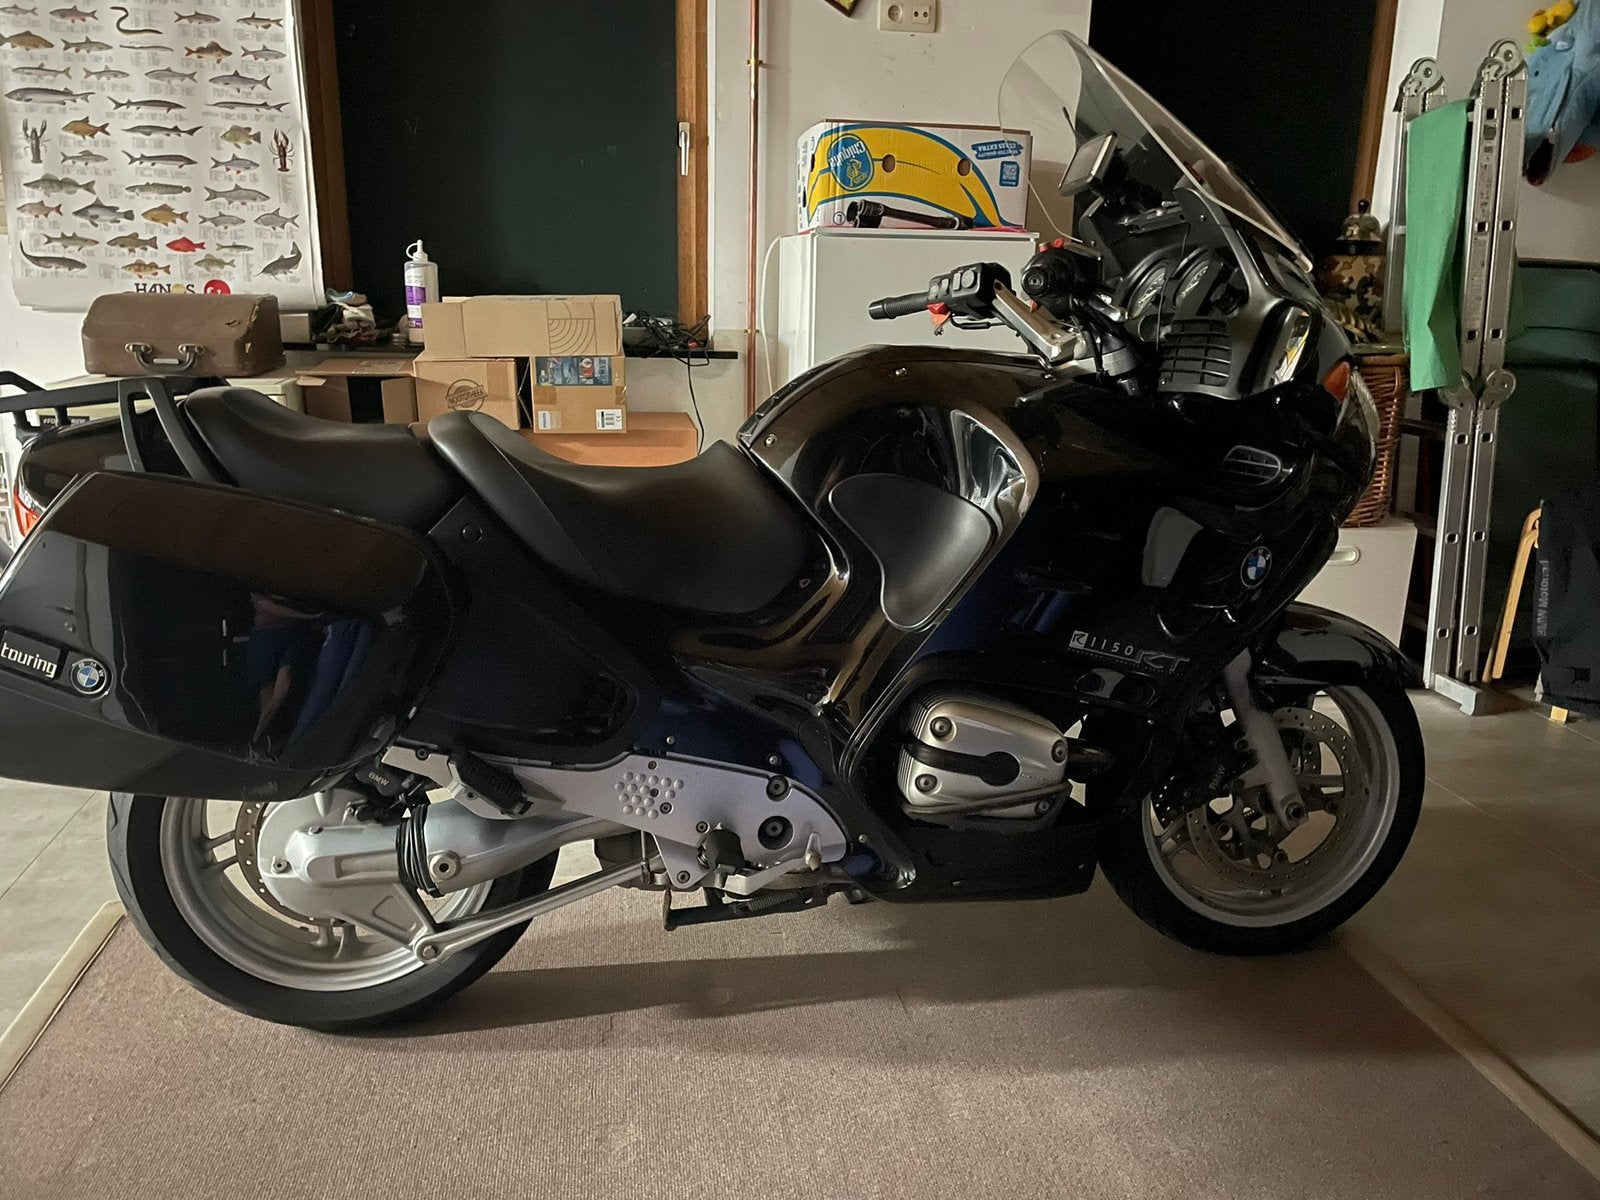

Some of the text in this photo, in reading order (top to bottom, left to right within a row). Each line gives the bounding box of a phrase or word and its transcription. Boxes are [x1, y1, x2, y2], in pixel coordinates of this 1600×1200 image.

[828, 140, 866, 169] Chiquita
[977, 143, 998, 152] EXTRA
[0, 642, 57, 678] touring
[368, 771, 390, 786] BMW
